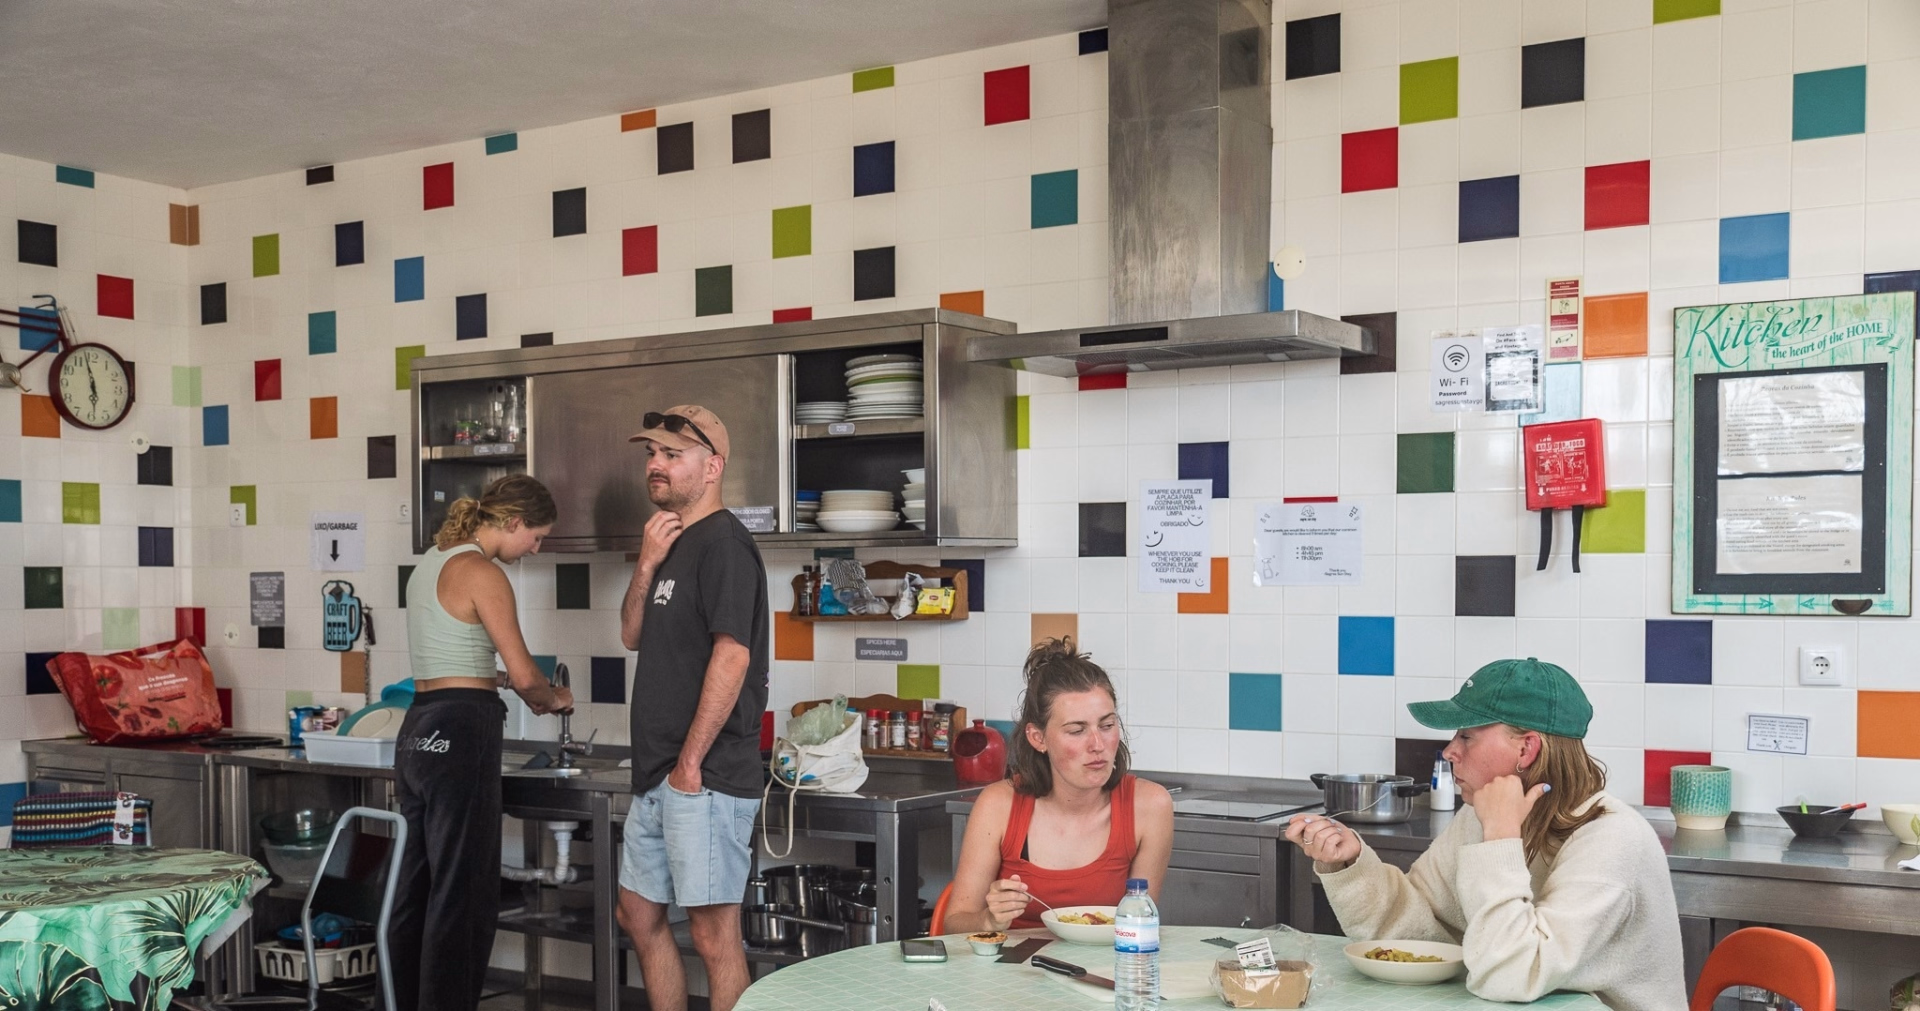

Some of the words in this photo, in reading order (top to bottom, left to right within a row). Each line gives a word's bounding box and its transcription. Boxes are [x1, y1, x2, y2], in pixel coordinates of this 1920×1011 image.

[1676, 305, 1823, 368] Kitchen
[1772, 349, 1787, 358] the
[1790, 344, 1815, 356] heart
[1818, 338, 1827, 351] of
[1830, 332, 1844, 344] the
[1846, 322, 1883, 338] HOME
[74, 356, 82, 367] 11
[87, 352, 98, 363] 12
[64, 364, 74, 375] 10
[105, 360, 108, 370] 1
[111, 372, 118, 382] 2
[61, 378, 68, 387] 9
[1440, 379, 1456, 387] Wi-
[115, 385, 122, 395] 3
[64, 393, 72, 403] 8
[113, 399, 118, 408] 4
[74, 406, 80, 416] 7
[87, 411, 95, 421] 6
[102, 410, 110, 421] 5
[315, 522, 358, 531] LIXO/GARBAGE
[327, 604, 347, 616] CRAFT
[327, 622, 347, 645] BEER
